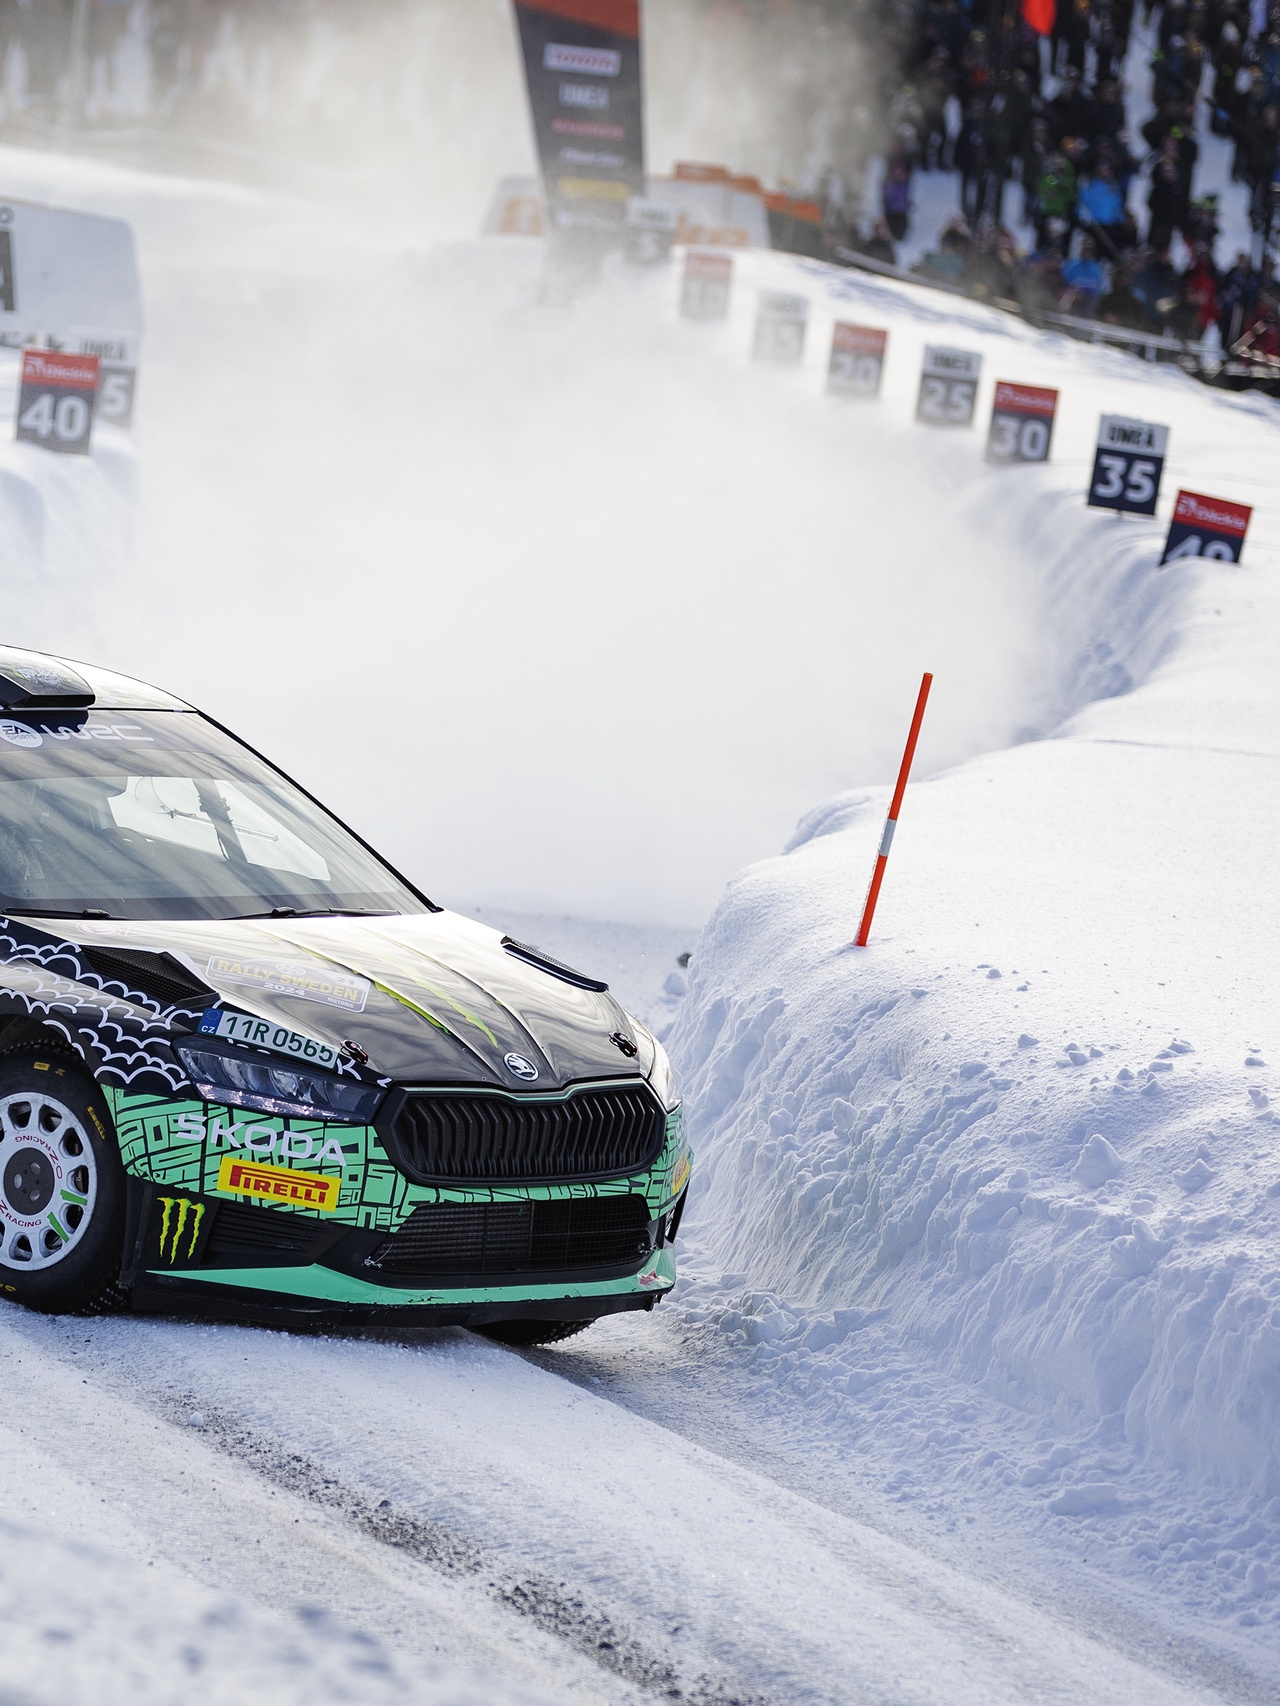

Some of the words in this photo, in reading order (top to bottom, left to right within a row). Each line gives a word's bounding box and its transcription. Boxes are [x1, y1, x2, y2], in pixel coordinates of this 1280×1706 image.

[20, 393, 89, 442] 40
[920, 376, 971, 422] 25
[991, 415, 1050, 461] 30
[1093, 453, 1156, 505] 35
[216, 958, 275, 981] RALLY
[278, 972, 359, 1001] SWEDEN
[263, 980, 306, 998] 2024
[200, 1025, 216, 1034] CZ
[226, 1016, 270, 1043] 11R
[272, 1028, 334, 1063] 0565
[229, 1164, 330, 1204] PIRELLI
[5, 1211, 42, 1227] RACING
